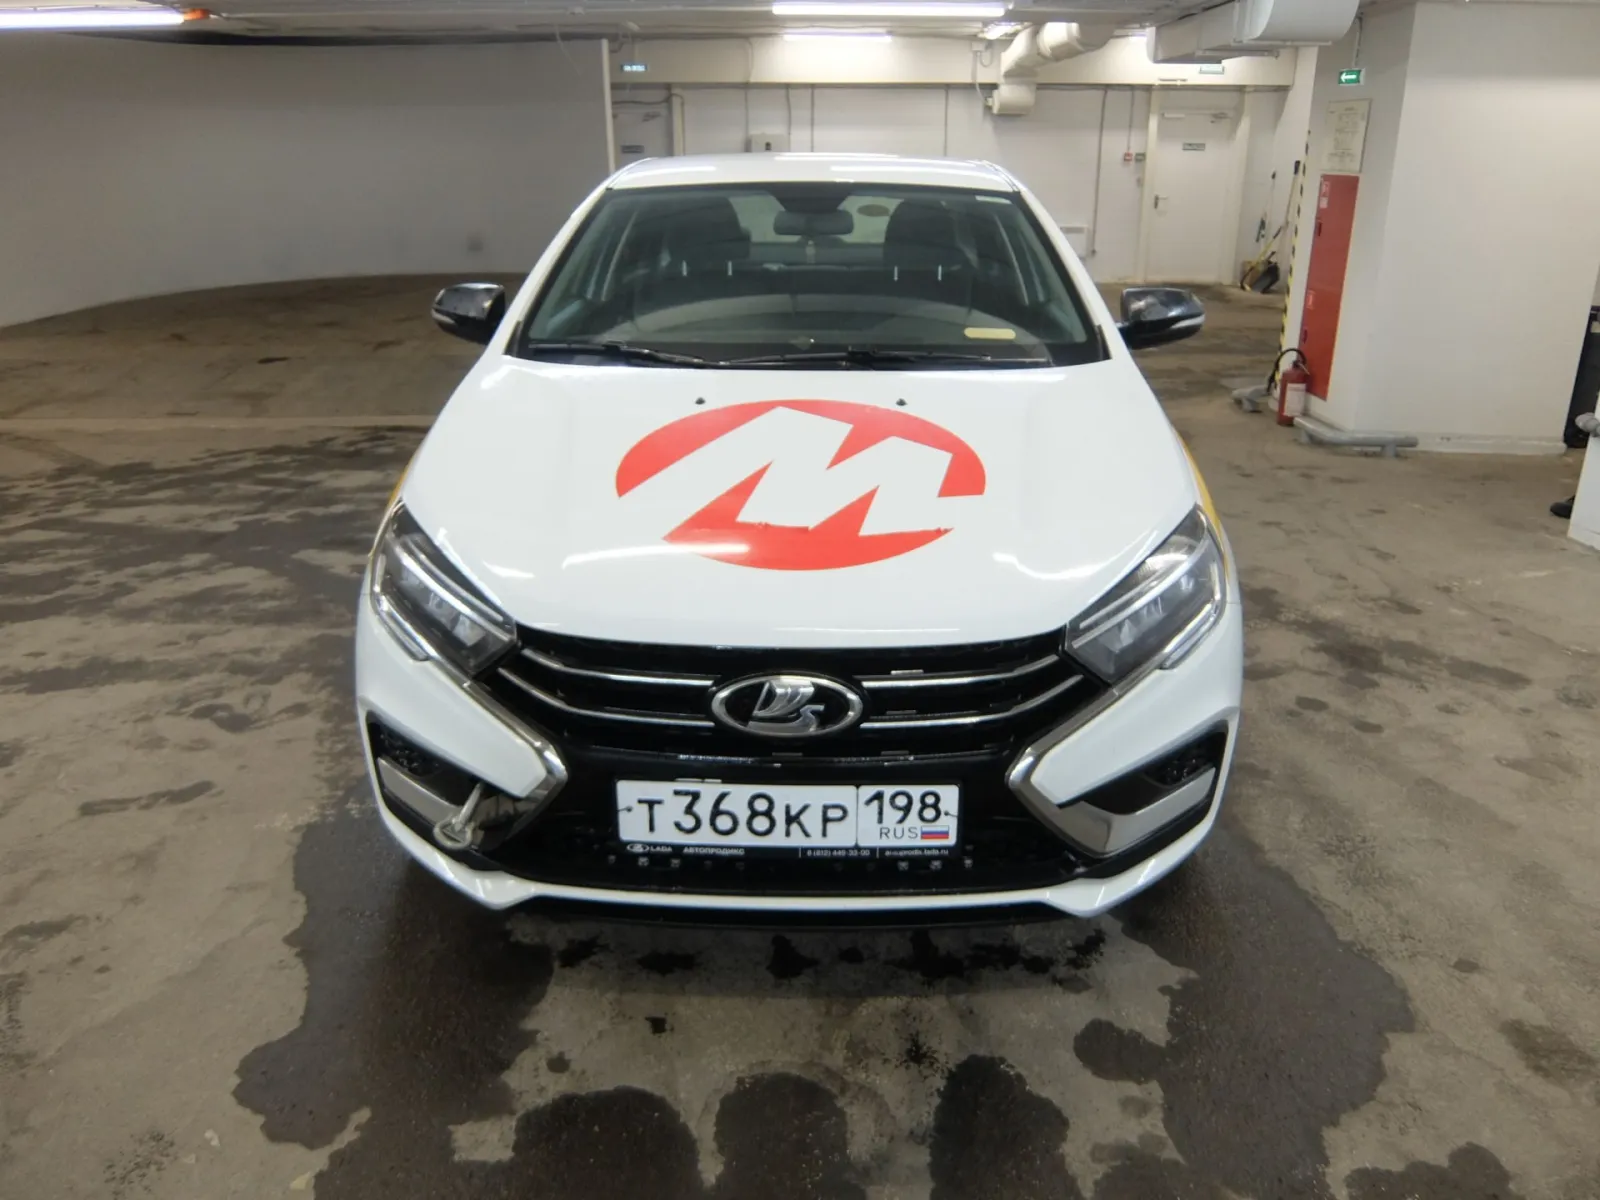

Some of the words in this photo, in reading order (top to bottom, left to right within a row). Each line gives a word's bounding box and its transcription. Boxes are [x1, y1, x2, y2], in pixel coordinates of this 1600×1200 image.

[637, 788, 849, 838] Т368КР
[863, 790, 942, 824] 198
[880, 827, 919, 839] RUS
[650, 845, 673, 853] LADA
